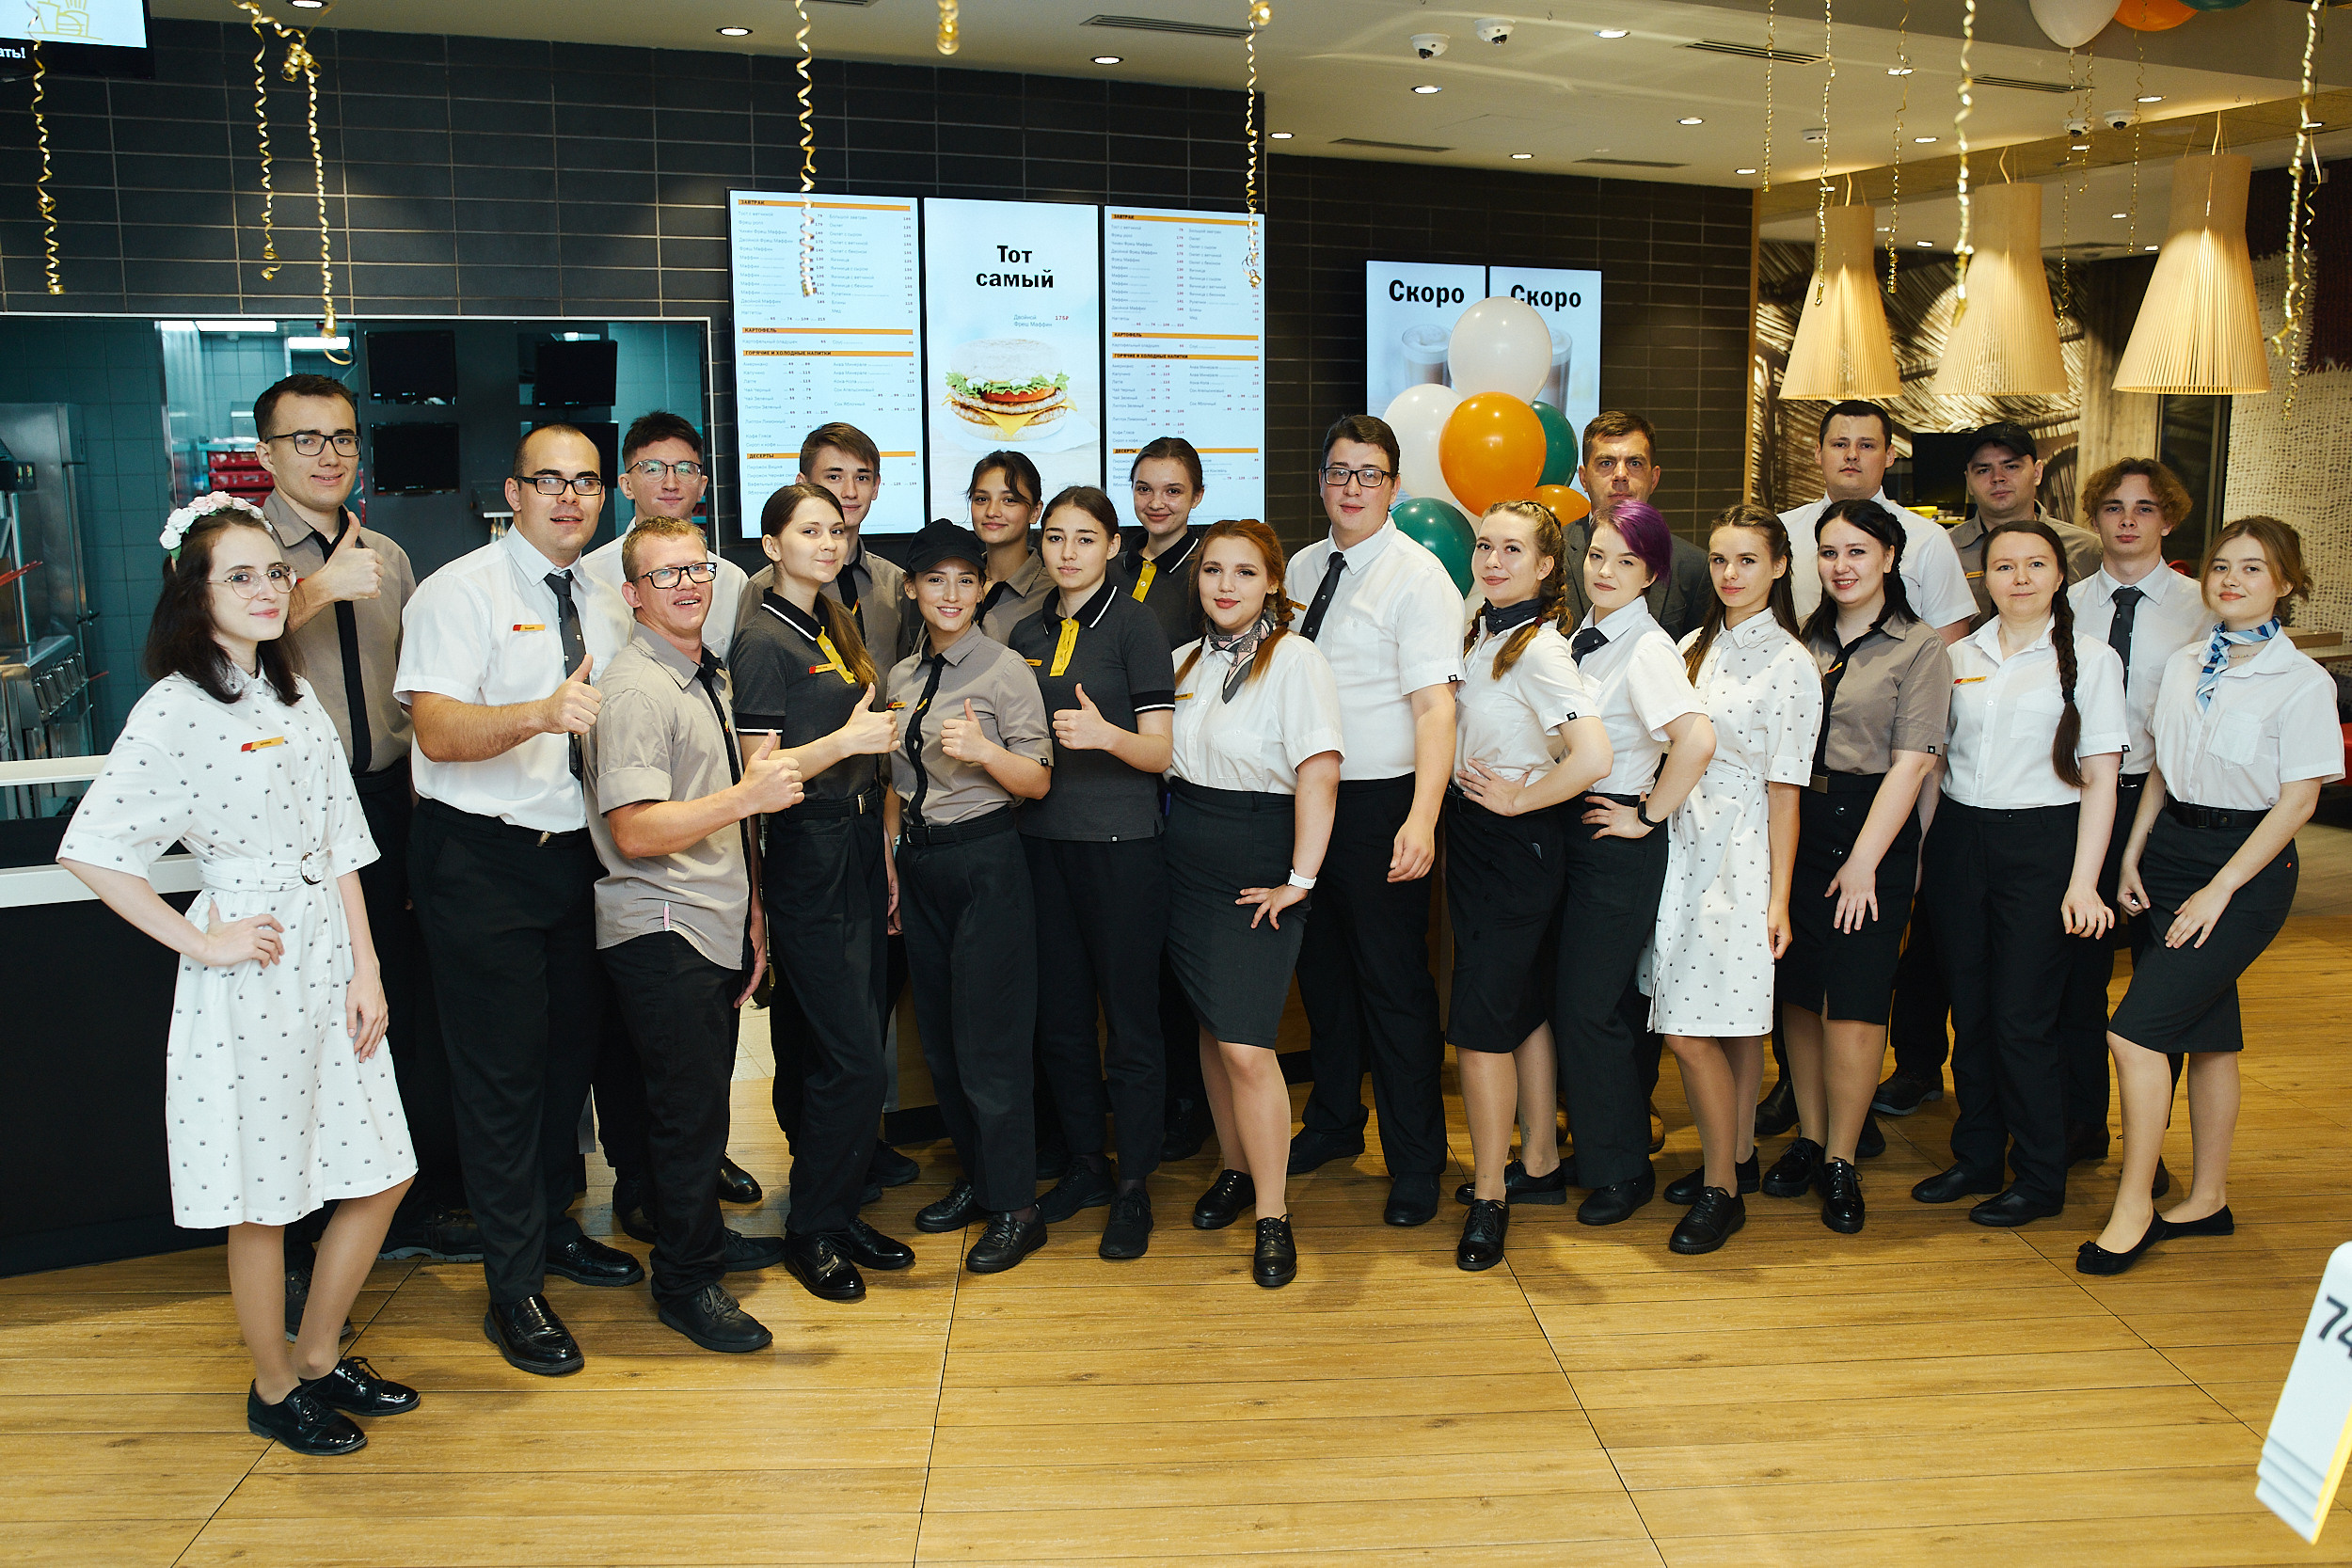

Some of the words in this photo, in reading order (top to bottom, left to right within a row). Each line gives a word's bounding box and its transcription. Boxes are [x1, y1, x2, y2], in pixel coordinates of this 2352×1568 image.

[996, 245, 1033, 263] Тот
[976, 269, 1054, 288] самый
[1389, 279, 1465, 308] Скоро
[1511, 284, 1581, 311] Скоро
